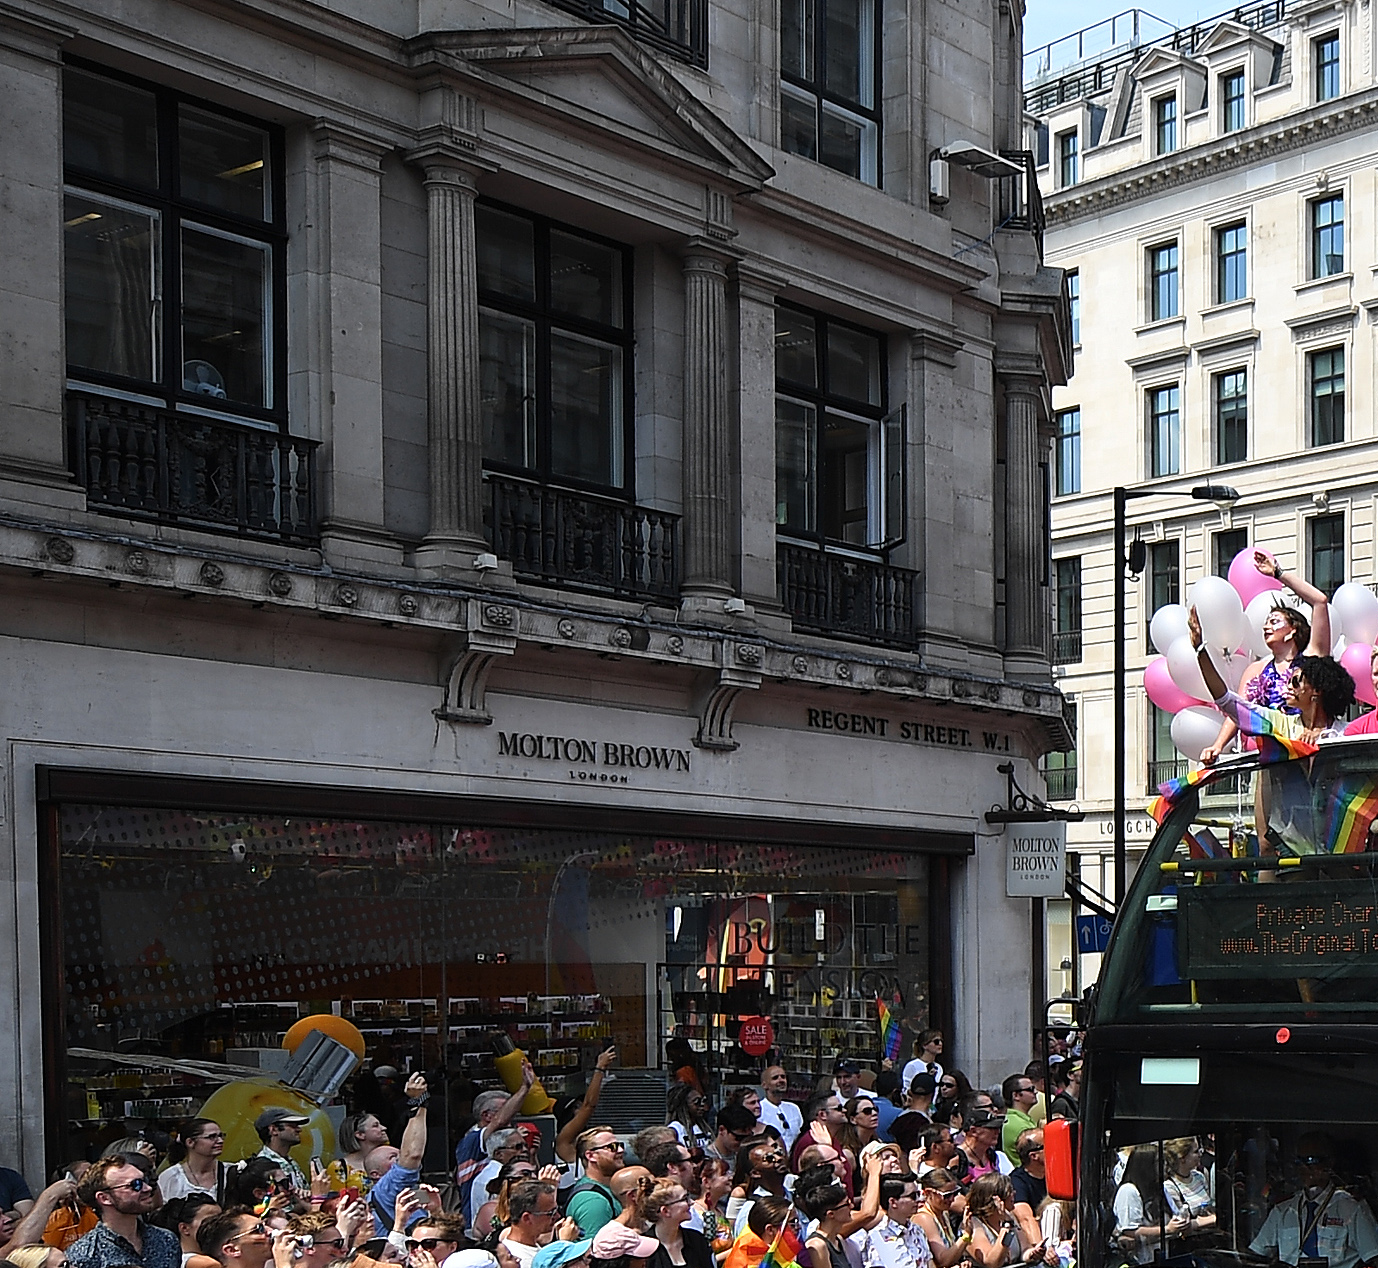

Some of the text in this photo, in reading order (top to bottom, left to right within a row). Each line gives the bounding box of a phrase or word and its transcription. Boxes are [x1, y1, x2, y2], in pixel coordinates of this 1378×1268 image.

[807, 708, 889, 736] REGENT
[498, 732, 691, 772] MOLTON BROWN
[570, 771, 628, 783] LONDON
[1100, 821, 1152, 834] LOGCH
[1012, 838, 1060, 853] MOLTON
[1012, 856, 1059, 872] BROWN
[1256, 903, 1325, 929] Private
[854, 922, 920, 956] THE
[745, 1025, 767, 1035] SALE
